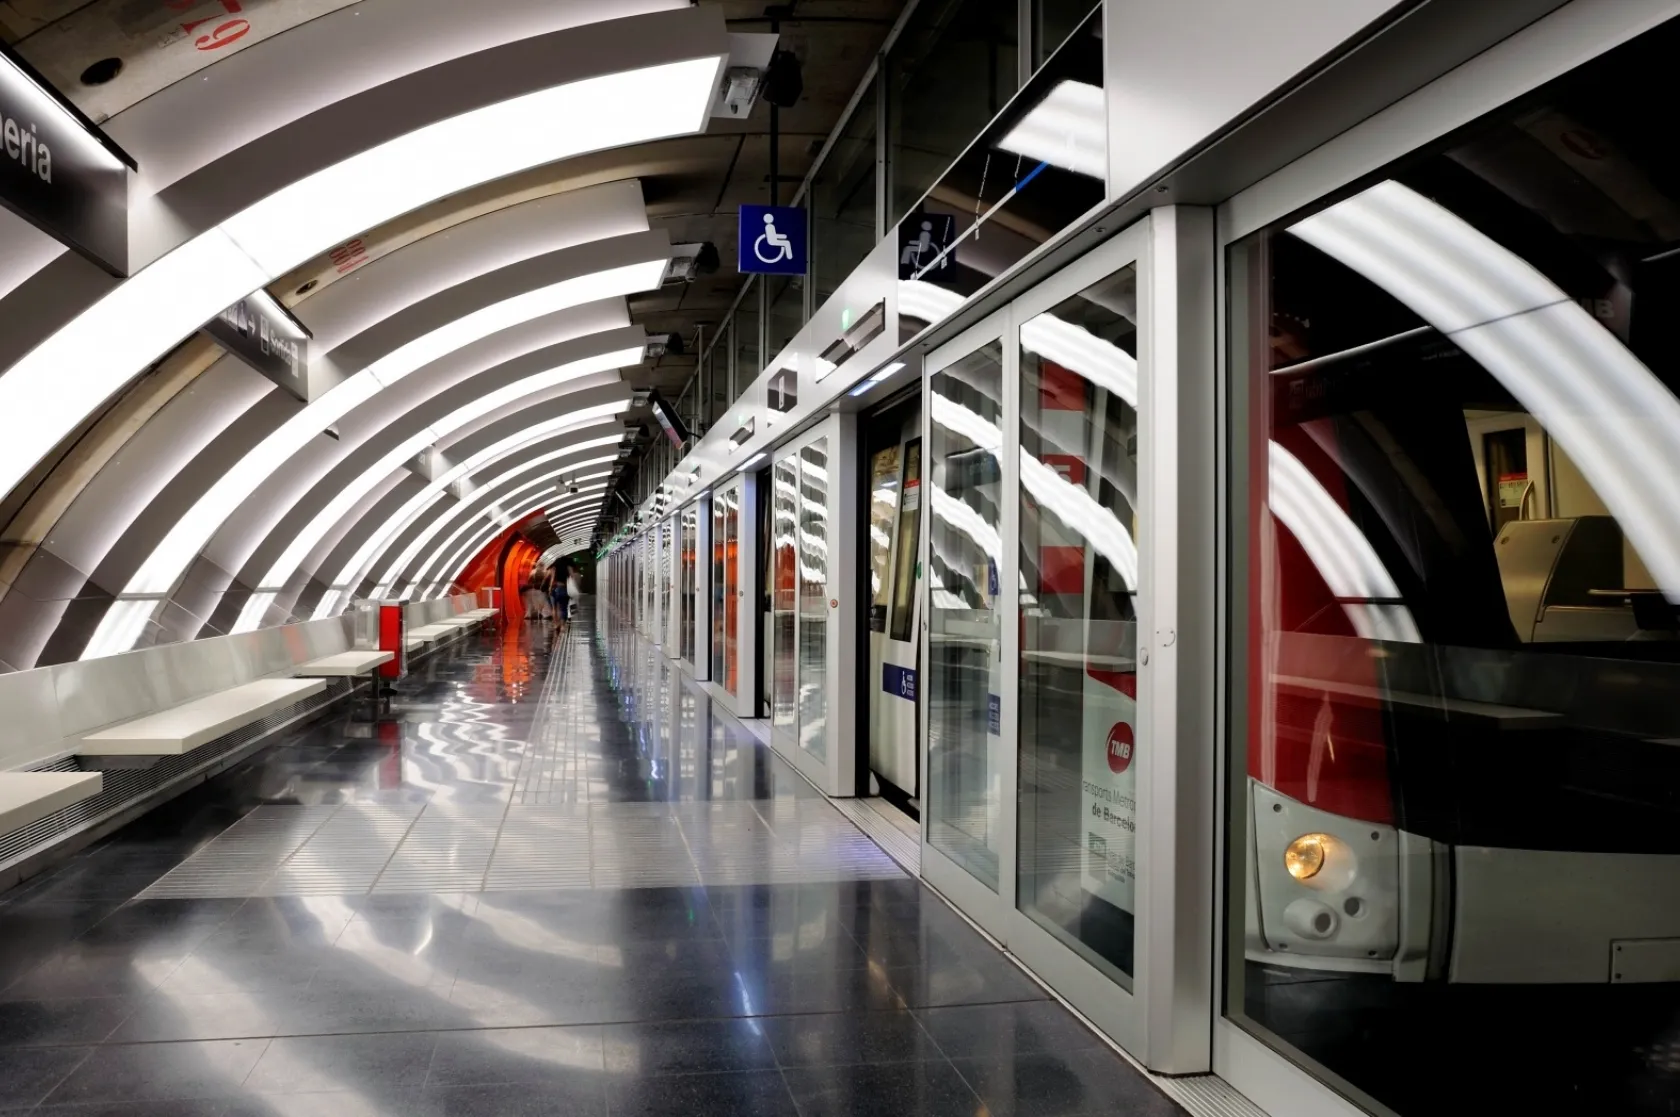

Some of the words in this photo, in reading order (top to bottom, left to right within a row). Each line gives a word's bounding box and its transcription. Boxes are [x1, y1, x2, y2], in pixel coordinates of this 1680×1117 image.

[1111, 739, 1131, 759] TMB
[1083, 781, 1111, 802] ransports
[1092, 802, 1101, 818] de
[1103, 806, 1136, 833] Barcelo
